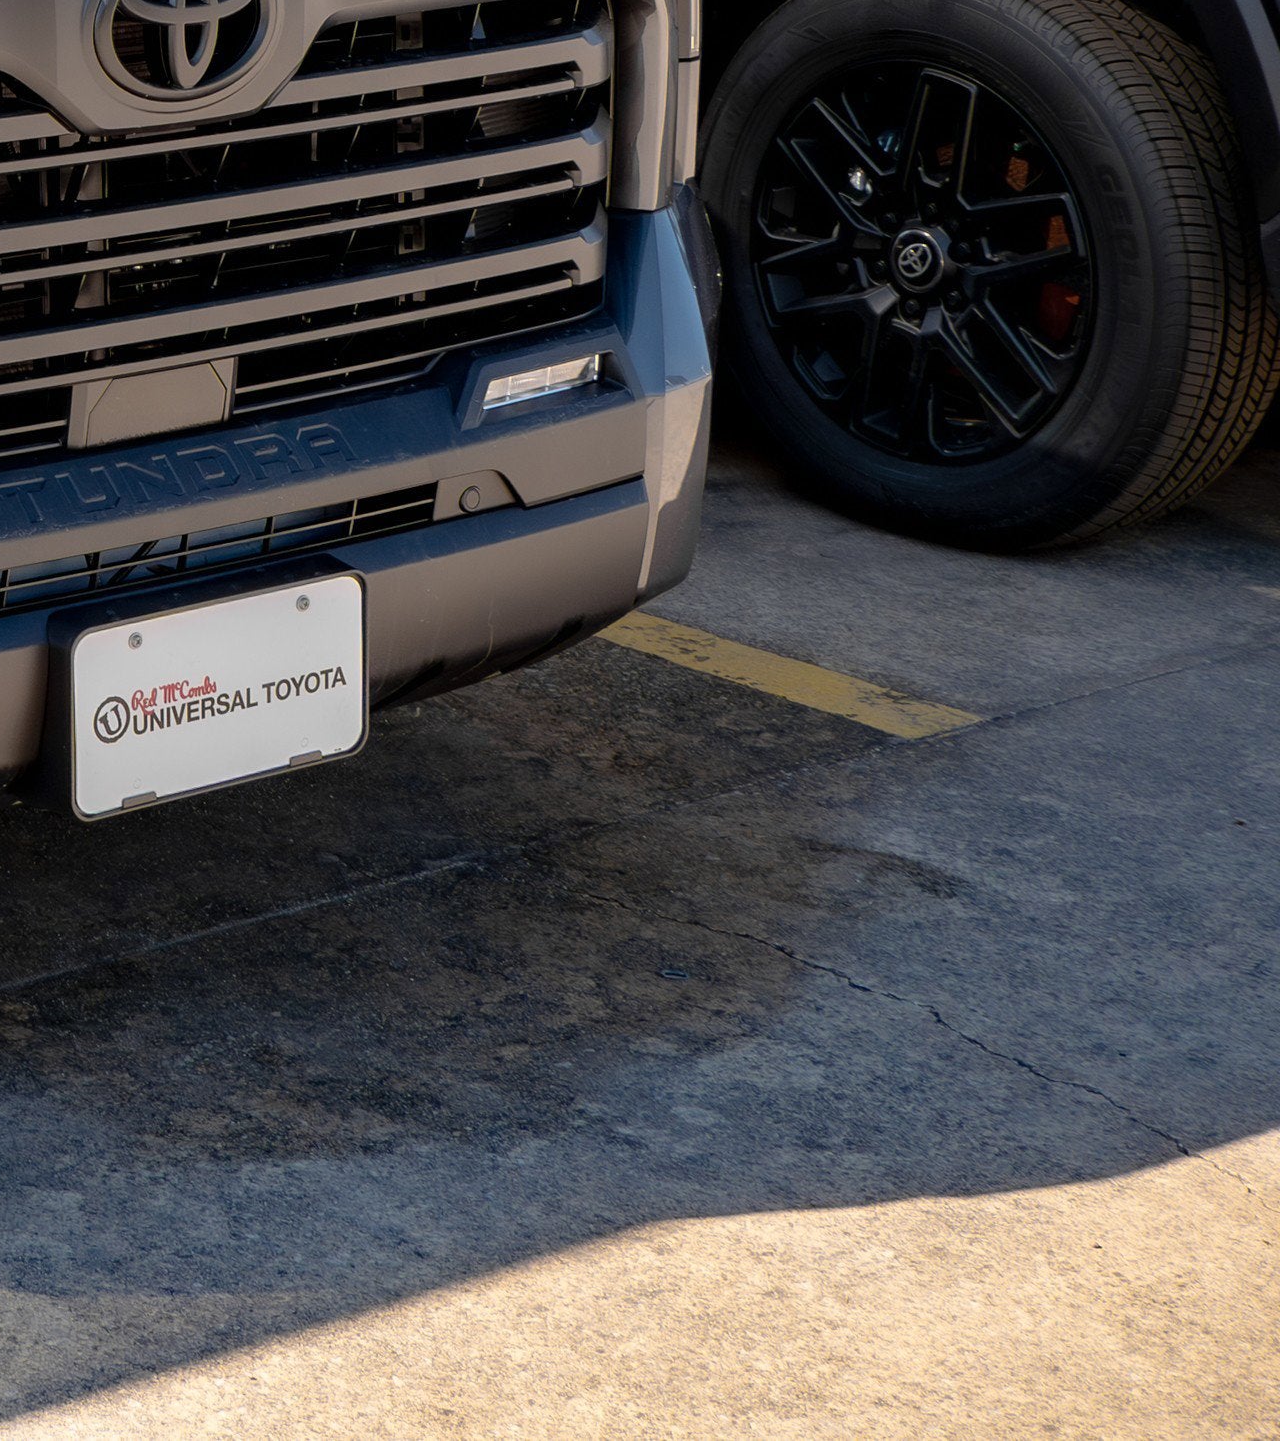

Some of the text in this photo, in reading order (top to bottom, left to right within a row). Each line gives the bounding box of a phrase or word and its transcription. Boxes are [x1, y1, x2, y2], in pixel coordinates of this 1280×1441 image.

[131, 676, 217, 715] Red McCombs
[132, 666, 347, 735] UNIVERSAL TOYOTA
